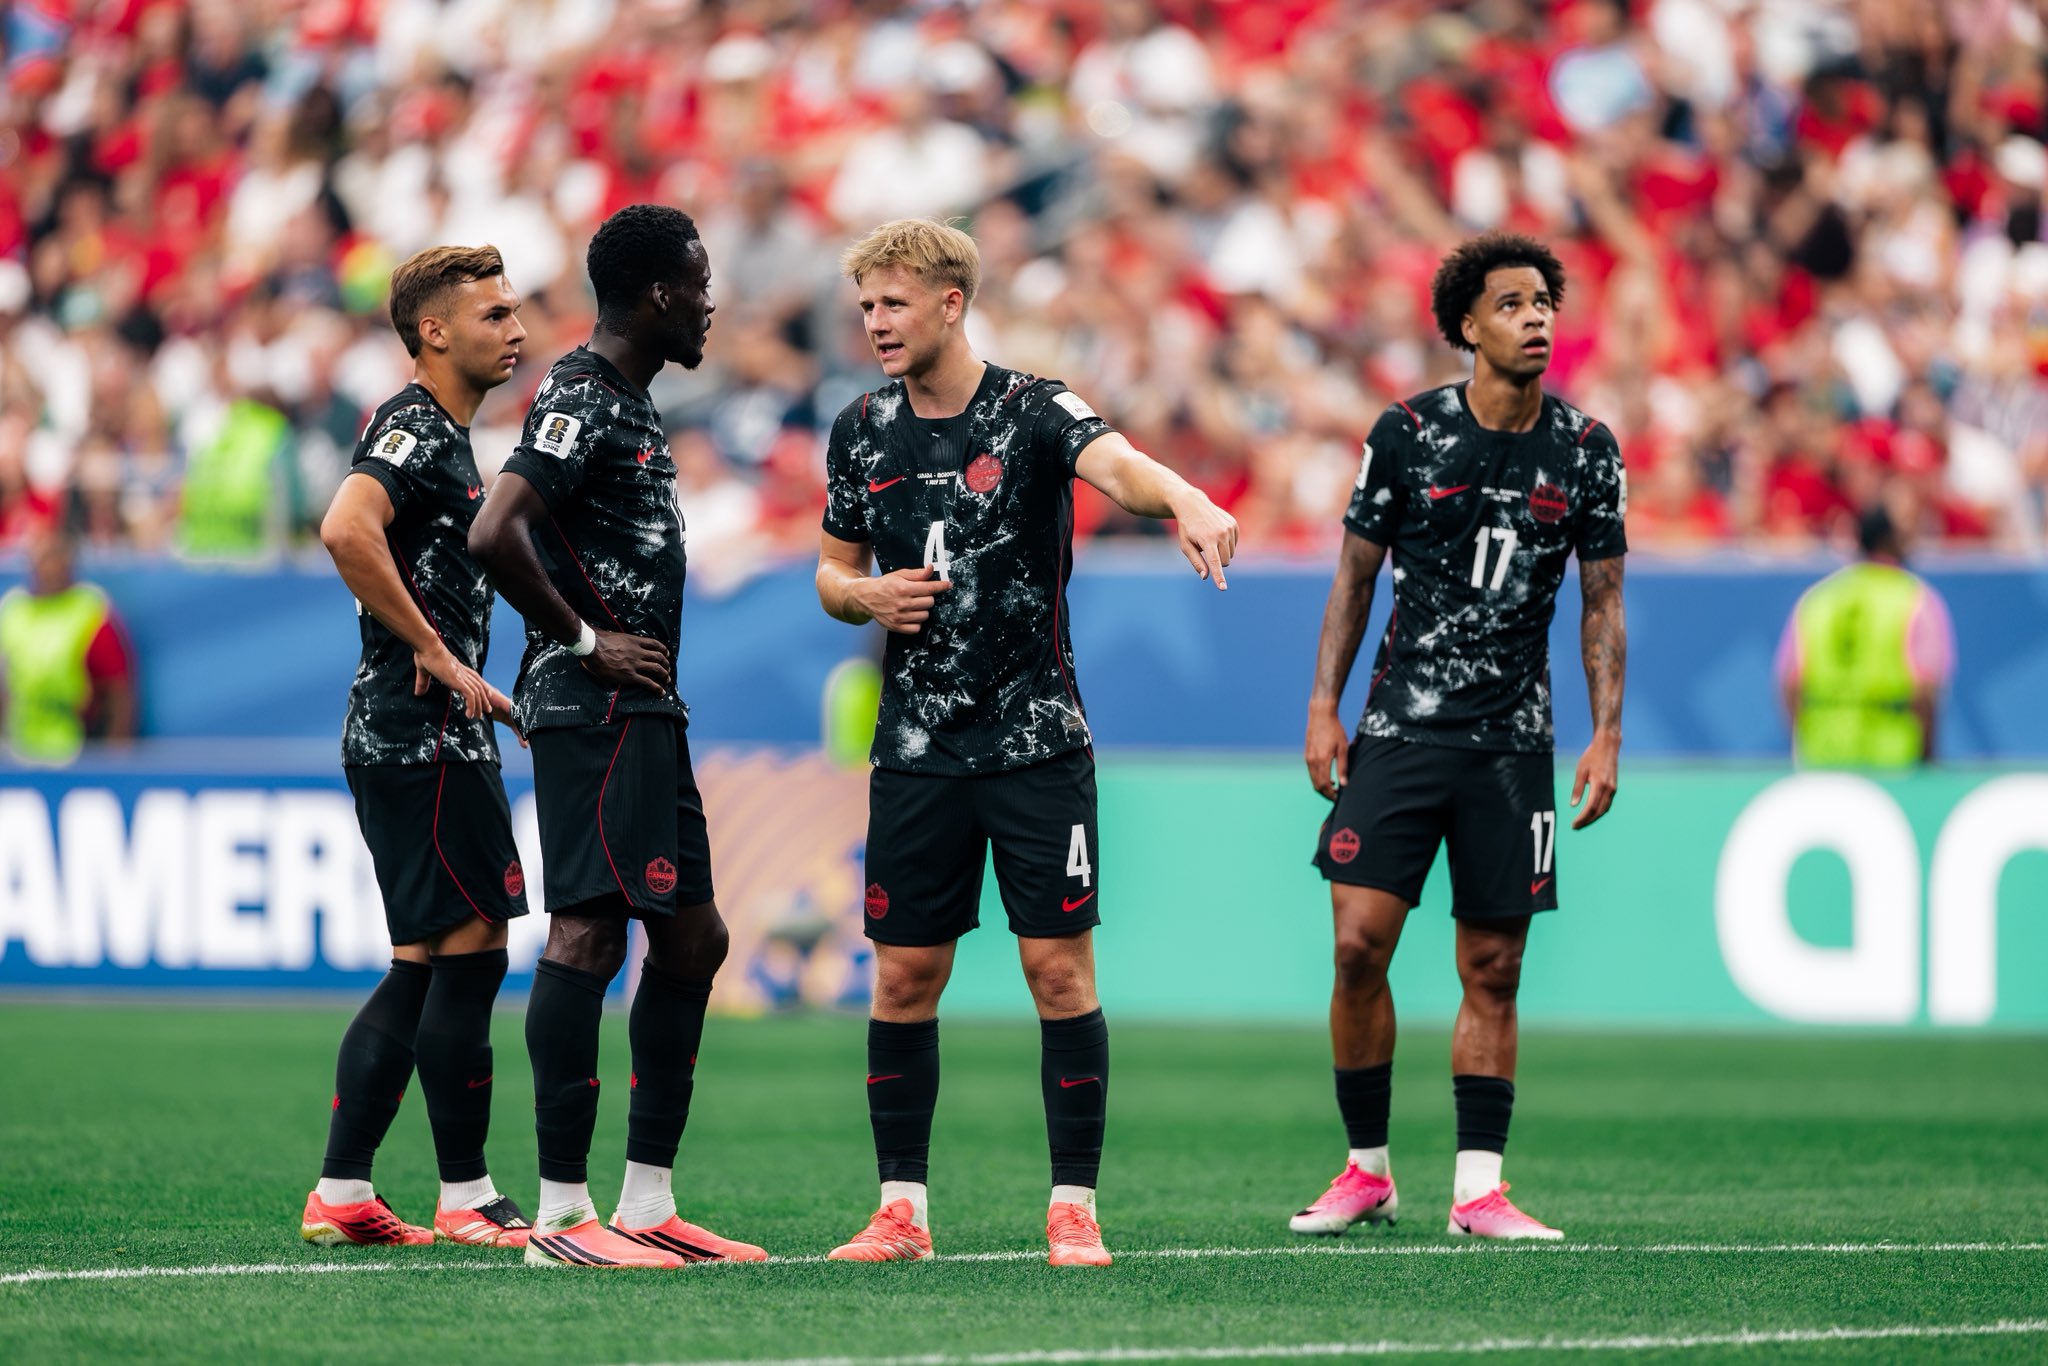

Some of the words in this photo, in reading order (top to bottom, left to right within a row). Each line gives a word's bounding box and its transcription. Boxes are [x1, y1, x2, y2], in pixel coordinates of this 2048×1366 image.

[924, 520, 951, 581] 4
[1471, 526, 1518, 591] 17
[1066, 823, 1091, 887] 4
[1530, 810, 1555, 874] 17
[0, 788, 552, 970] AMER
[648, 872, 675, 880] CANADA
